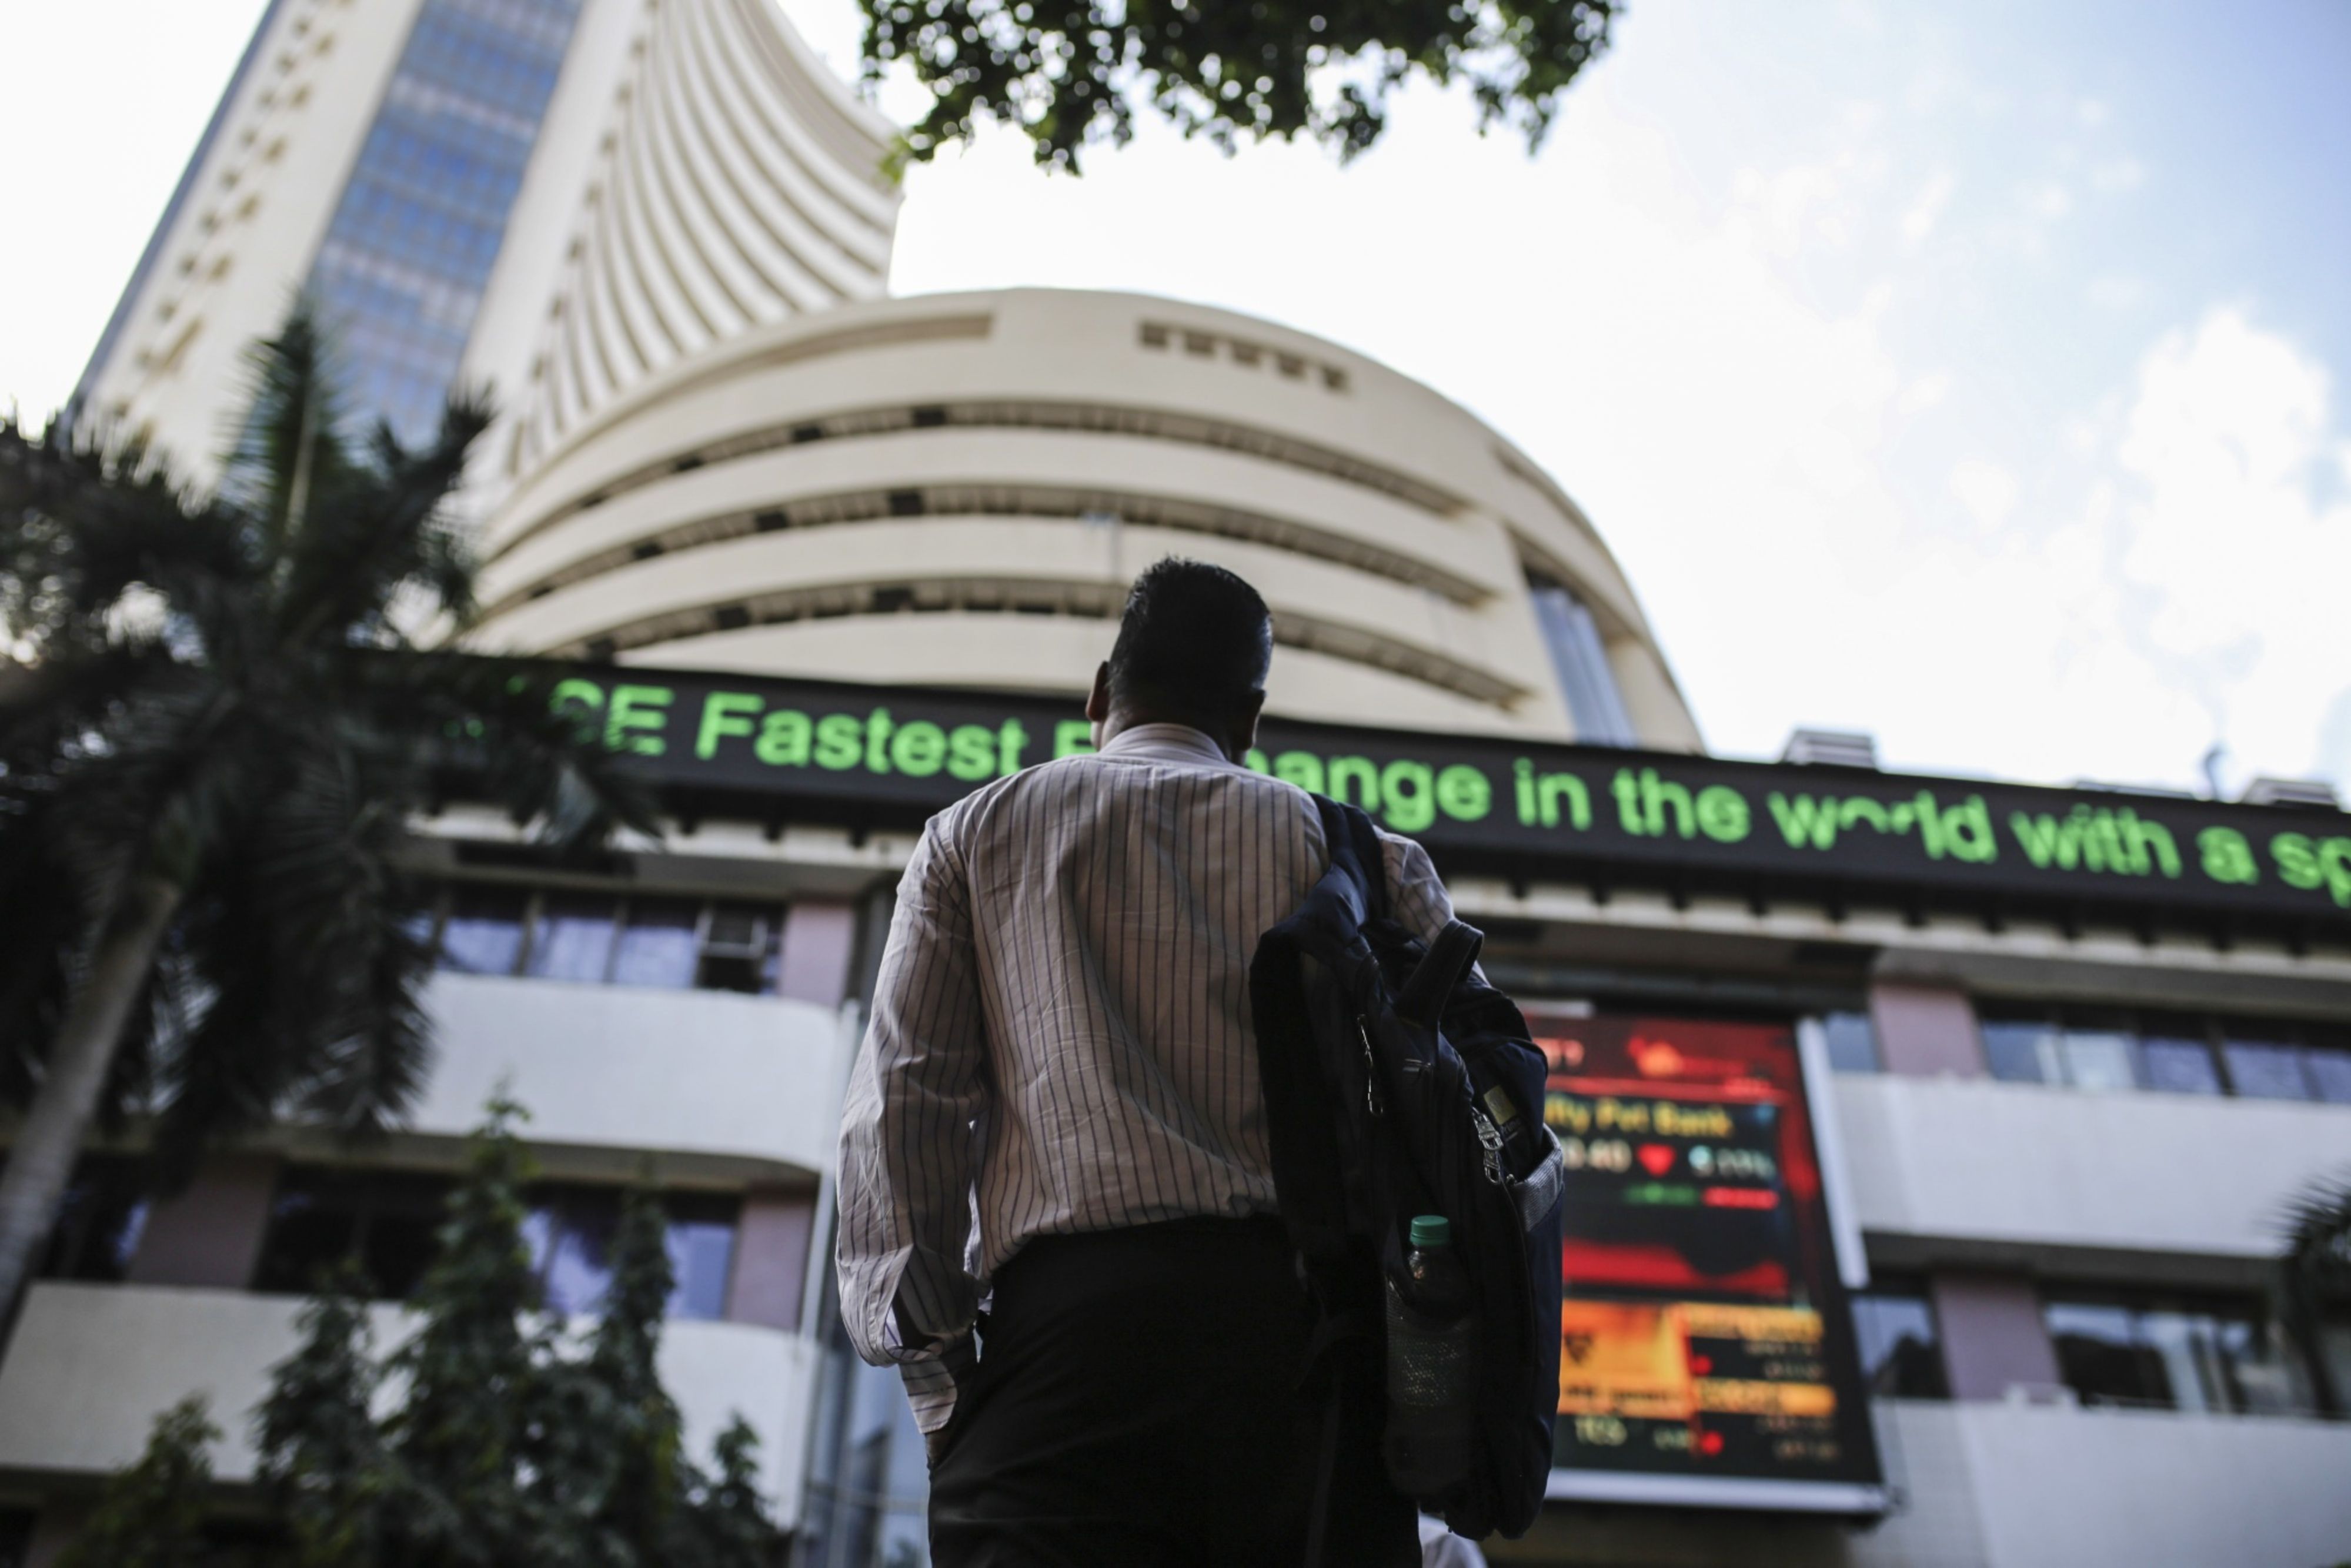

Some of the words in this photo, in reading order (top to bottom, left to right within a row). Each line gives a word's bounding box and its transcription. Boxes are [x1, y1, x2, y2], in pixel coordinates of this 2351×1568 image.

[695, 691, 1028, 781] Fastest
[1514, 757, 1592, 831] in
[1611, 767, 1751, 842] the
[2011, 803, 2182, 878] with
[2196, 825, 2259, 884] a
[2269, 831, 2351, 908] sp
